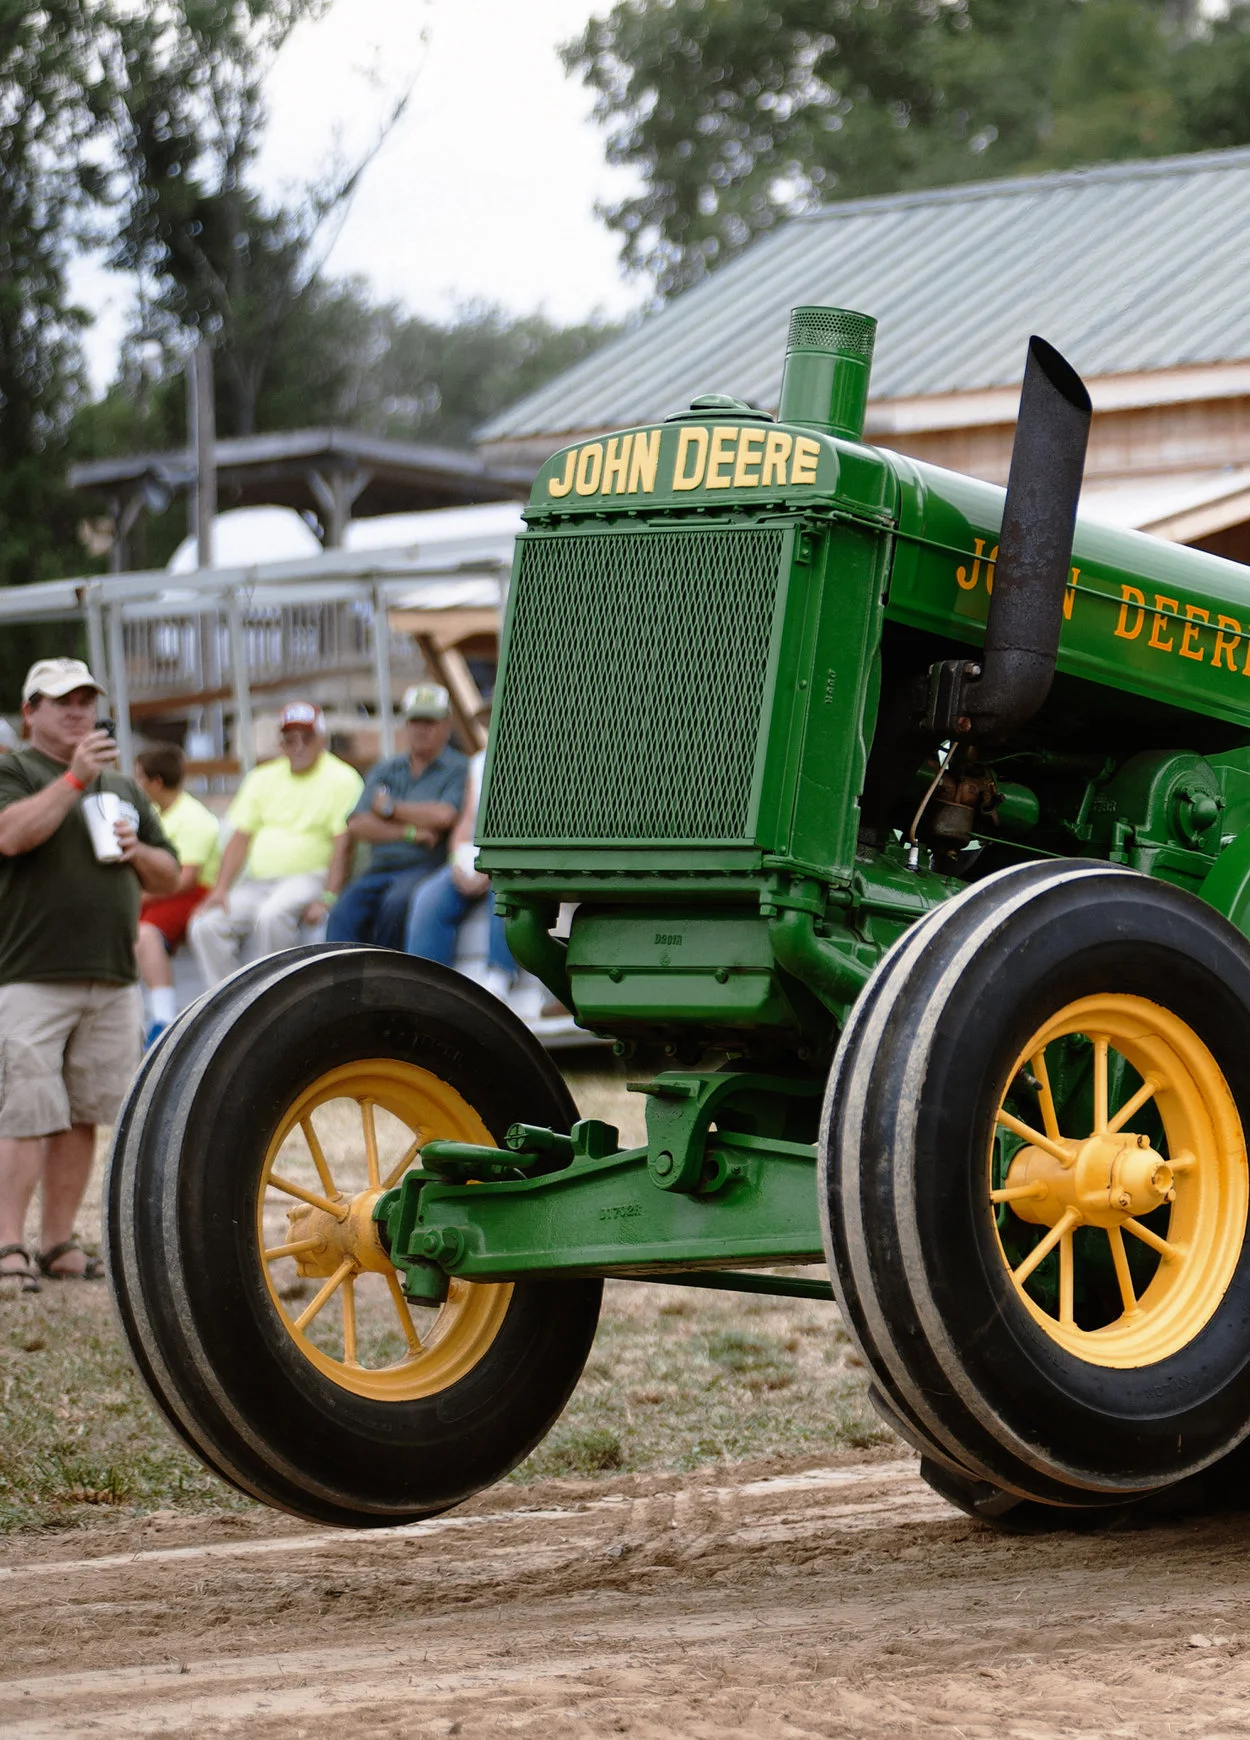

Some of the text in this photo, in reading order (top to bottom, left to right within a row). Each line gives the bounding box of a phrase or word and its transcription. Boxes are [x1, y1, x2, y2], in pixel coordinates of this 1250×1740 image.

[549, 426, 821, 498] JOHN DEERE
[956, 537, 1081, 620] JN
